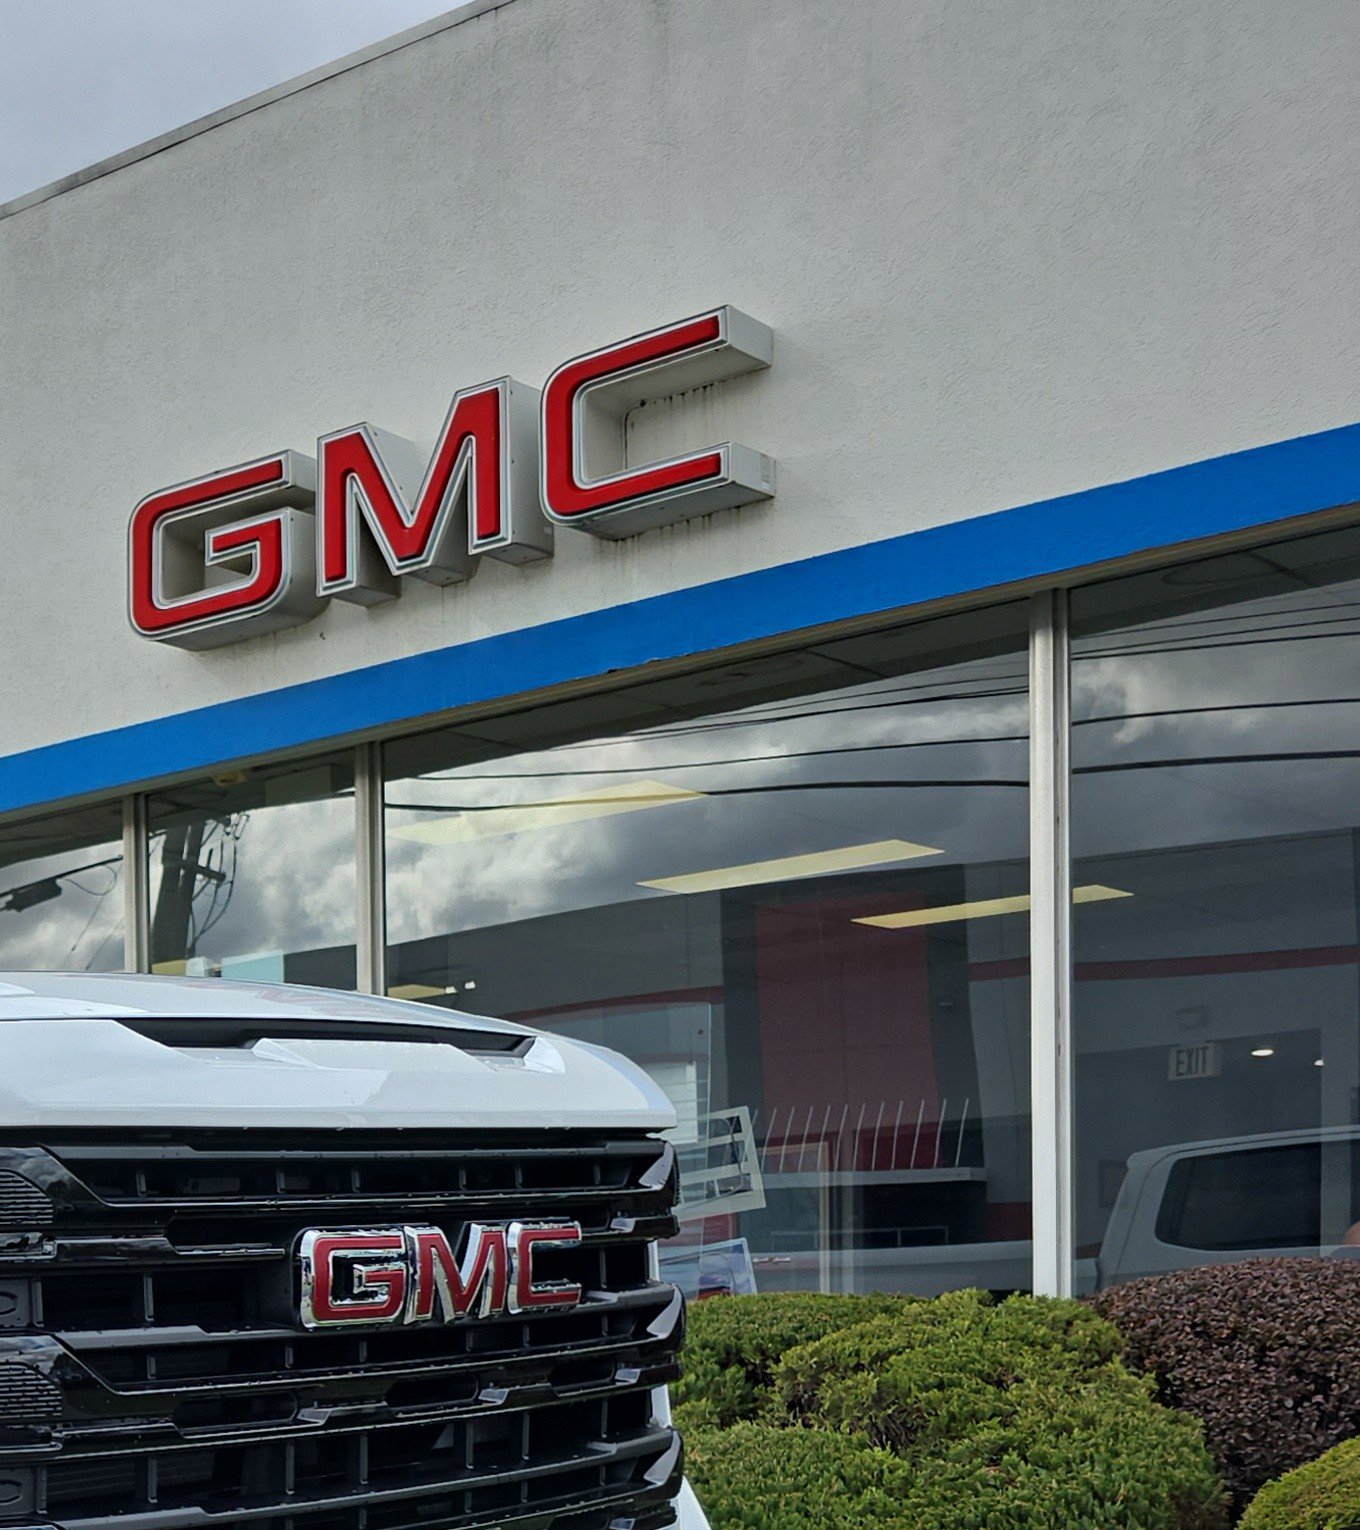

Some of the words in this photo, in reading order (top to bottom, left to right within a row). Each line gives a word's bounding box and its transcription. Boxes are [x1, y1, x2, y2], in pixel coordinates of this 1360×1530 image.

[127, 304, 735, 642] GMC
[1176, 1046, 1210, 1076] EXIT
[300, 1220, 582, 1331] GMC
